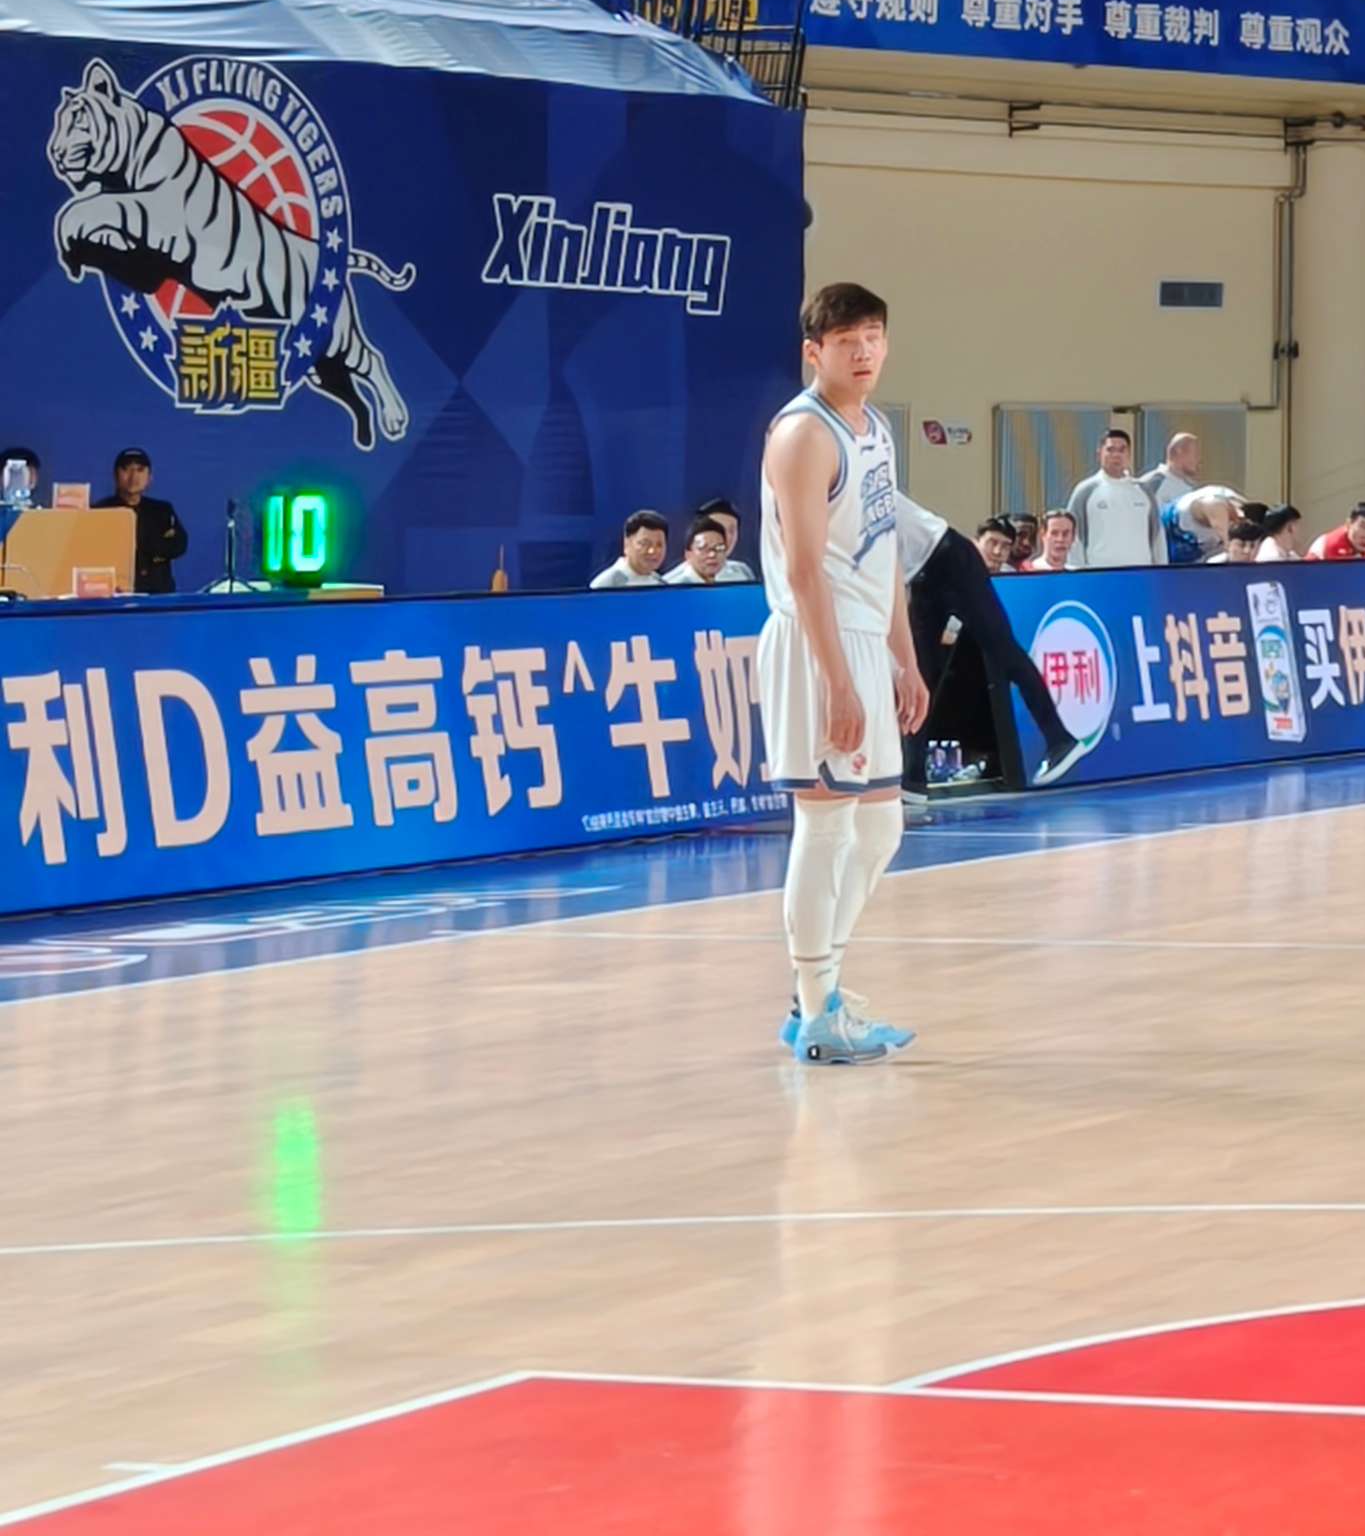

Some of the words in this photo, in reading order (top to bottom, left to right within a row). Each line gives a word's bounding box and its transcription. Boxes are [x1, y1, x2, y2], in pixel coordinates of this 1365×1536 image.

[1103, 0, 1221, 47] 尊重裁判
[1239, 11, 1351, 57] 尊重观众
[155, 75, 192, 115] XJ
[192, 60, 283, 116] FLYING
[280, 98, 344, 222] TIGERS
[480, 192, 732, 317] XinJiang
[178, 325, 283, 404] 新疆
[266, 493, 327, 573] 10
[1039, 649, 1100, 706] 伊利
[1131, 611, 1249, 723] 上抖音
